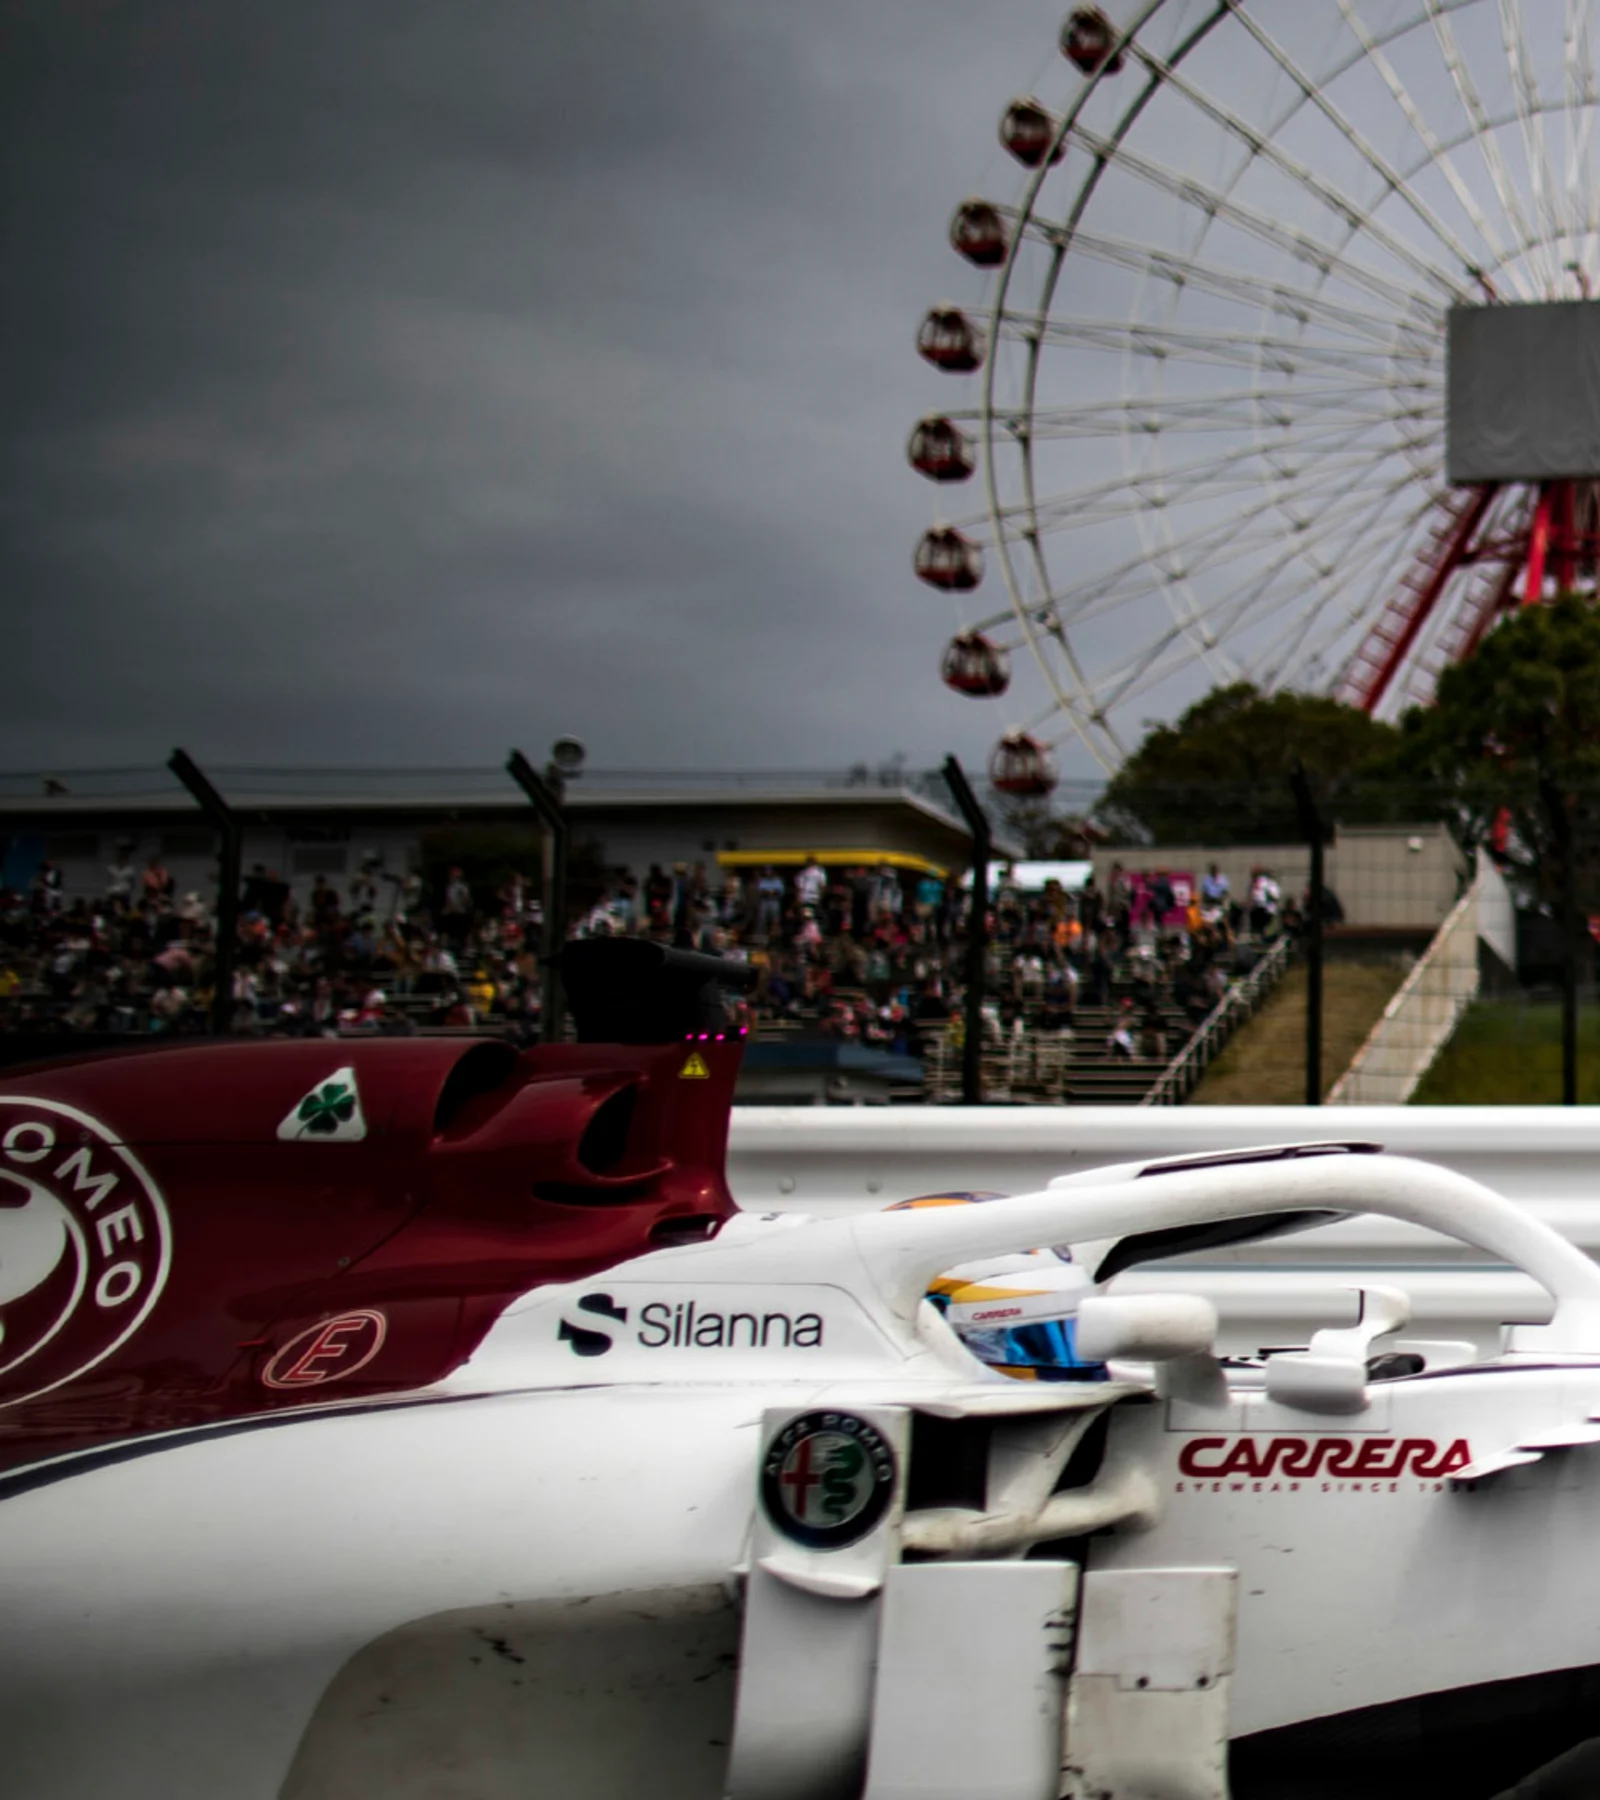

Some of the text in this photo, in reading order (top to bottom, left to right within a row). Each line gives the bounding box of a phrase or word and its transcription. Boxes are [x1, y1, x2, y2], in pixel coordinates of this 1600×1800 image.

[1, 1121, 144, 1308] OMEO
[279, 1319, 368, 1381] E
[637, 1301, 823, 1347] Silanna
[821, 1414, 892, 1483] ROMEO
[1177, 1437, 1473, 1479] CARRERA
[1175, 1482, 1301, 1493] EYEWEAR
[1320, 1482, 1399, 1493] SINCE
